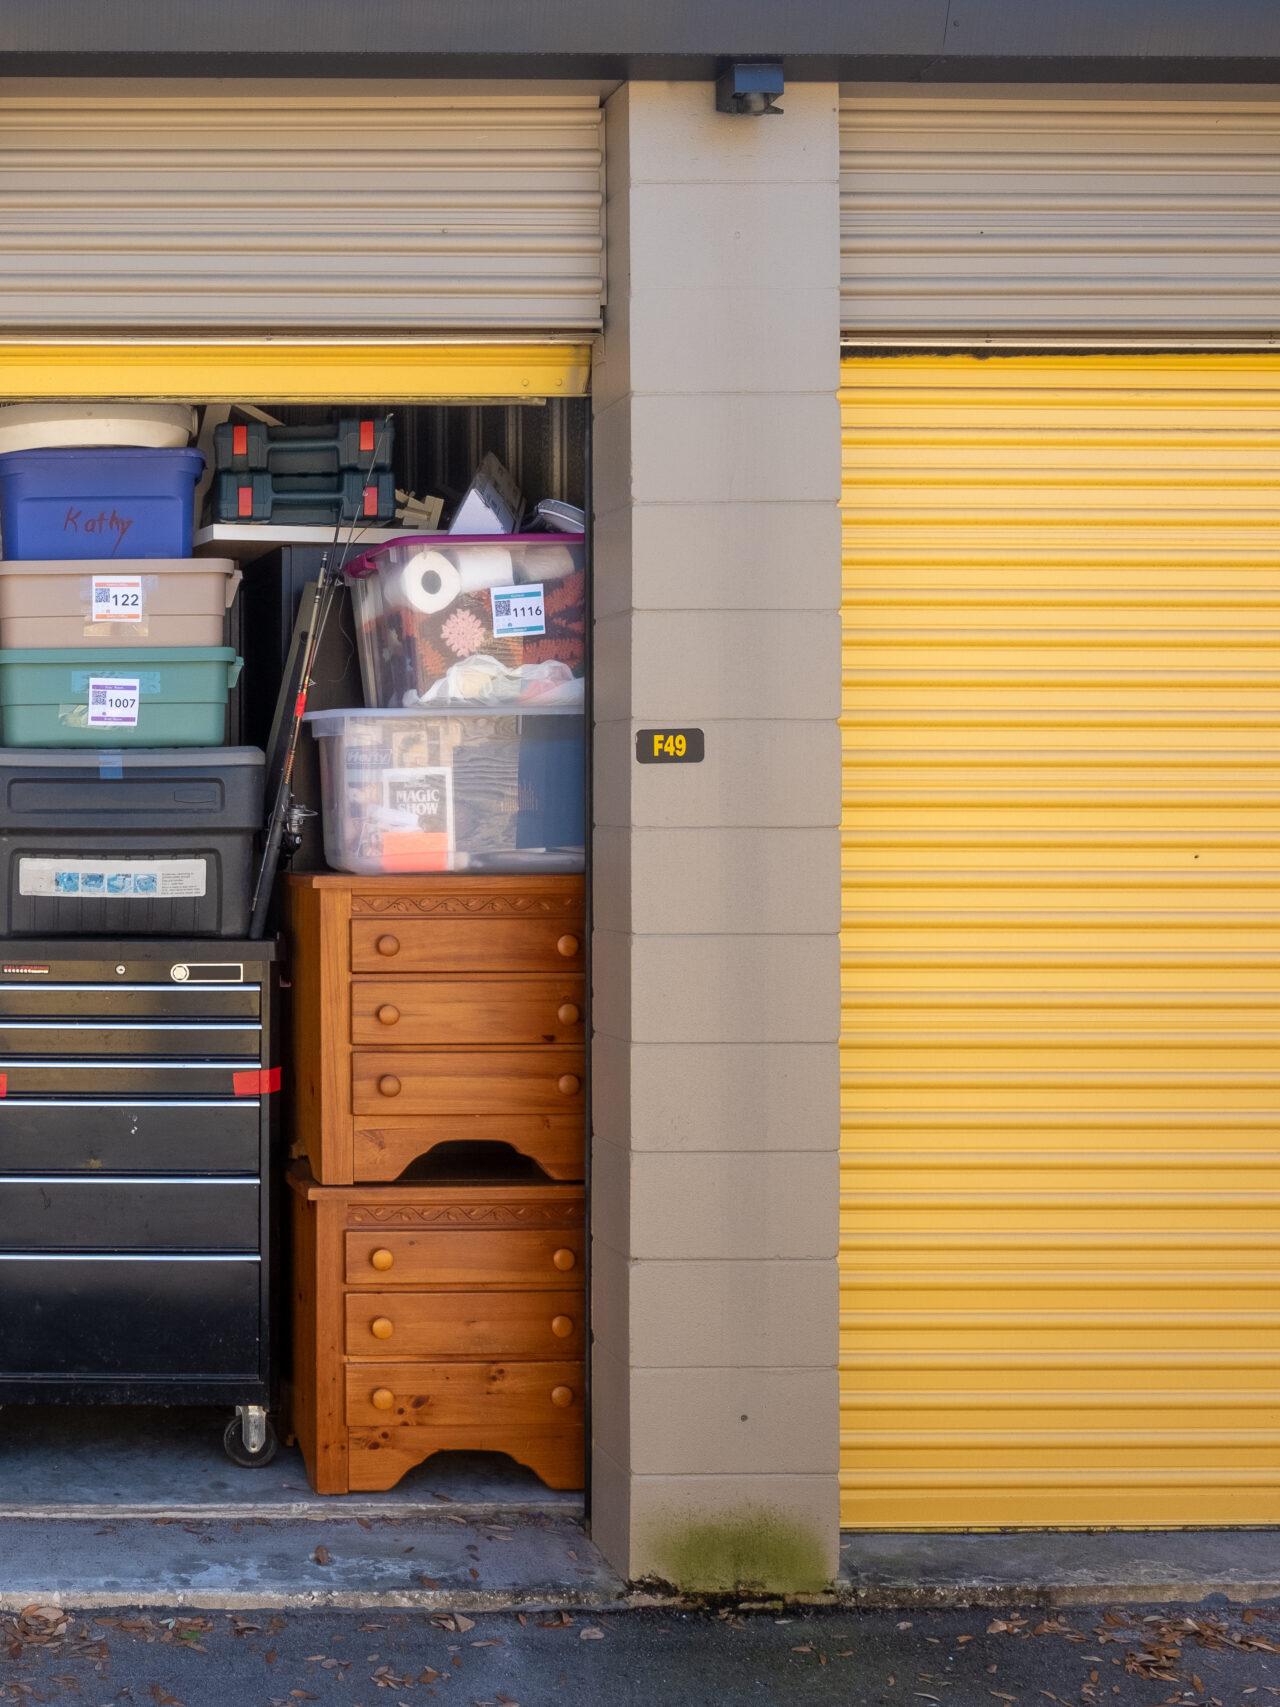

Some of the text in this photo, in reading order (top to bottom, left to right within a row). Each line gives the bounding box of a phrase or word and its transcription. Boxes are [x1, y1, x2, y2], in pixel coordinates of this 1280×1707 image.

[63, 506, 133, 556] Kathy
[112, 593, 139, 606] 122
[512, 606, 542, 617] 1116
[108, 699, 136, 708] 1007
[653, 734, 687, 757] F49
[396, 789, 440, 802] MAGIC
